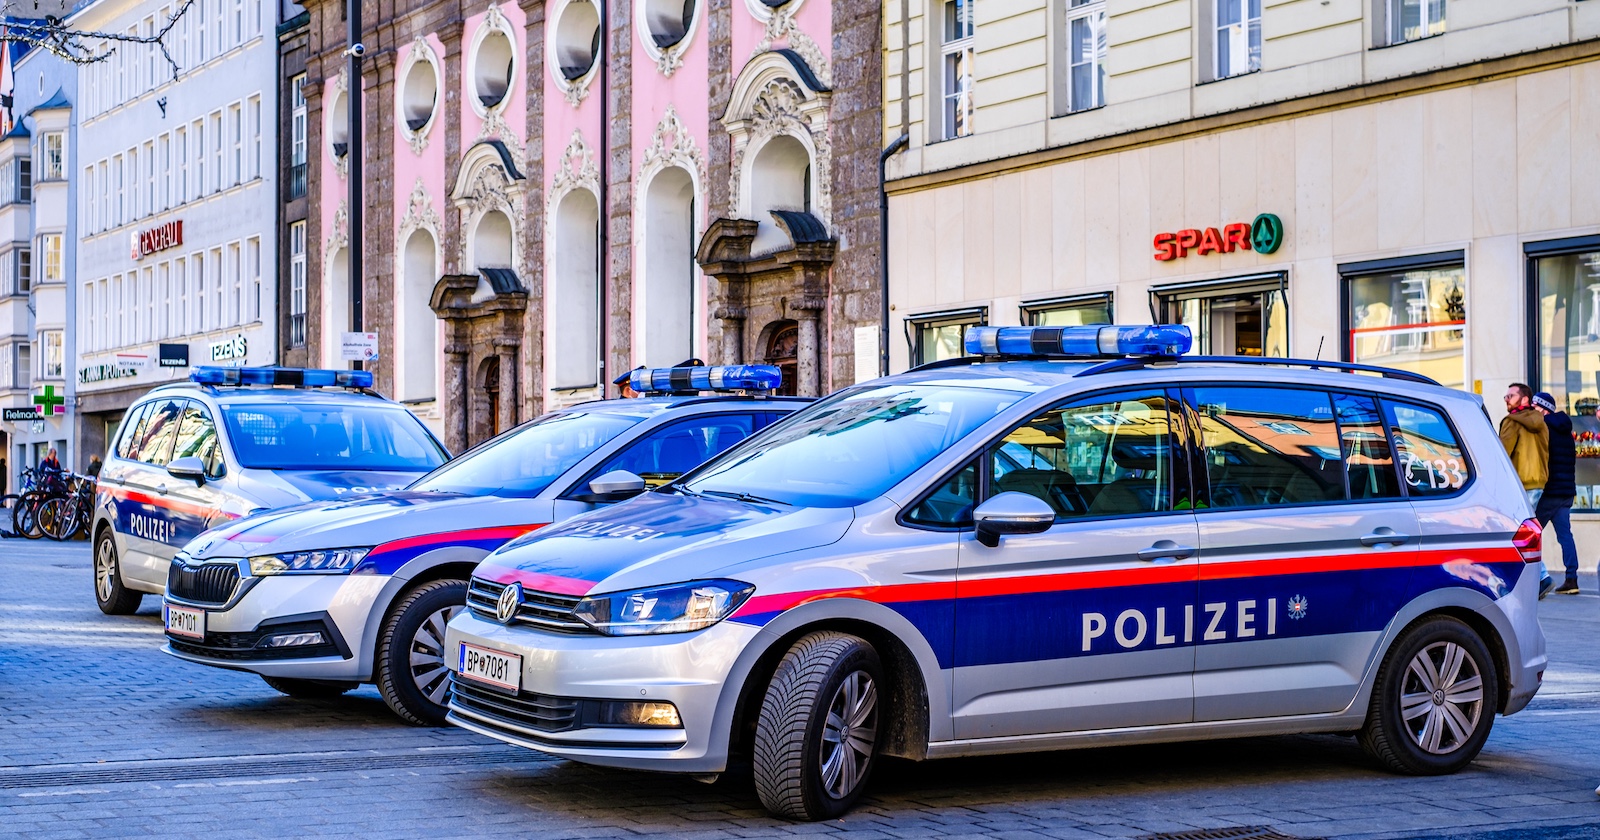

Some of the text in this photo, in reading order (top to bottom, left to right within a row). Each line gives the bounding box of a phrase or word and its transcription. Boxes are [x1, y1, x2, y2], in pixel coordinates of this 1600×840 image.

[141, 220, 182, 254] GENERALI
[1153, 222, 1252, 262] SPAR
[161, 358, 187, 366] TEZENIS
[209, 333, 248, 361] TEZENIS
[1423, 459, 1464, 489] 133
[131, 513, 169, 543] POLIZEI
[182, 613, 196, 632] 7101
[1082, 598, 1277, 652] POLIZEI
[468, 650, 509, 682] BP 7081
